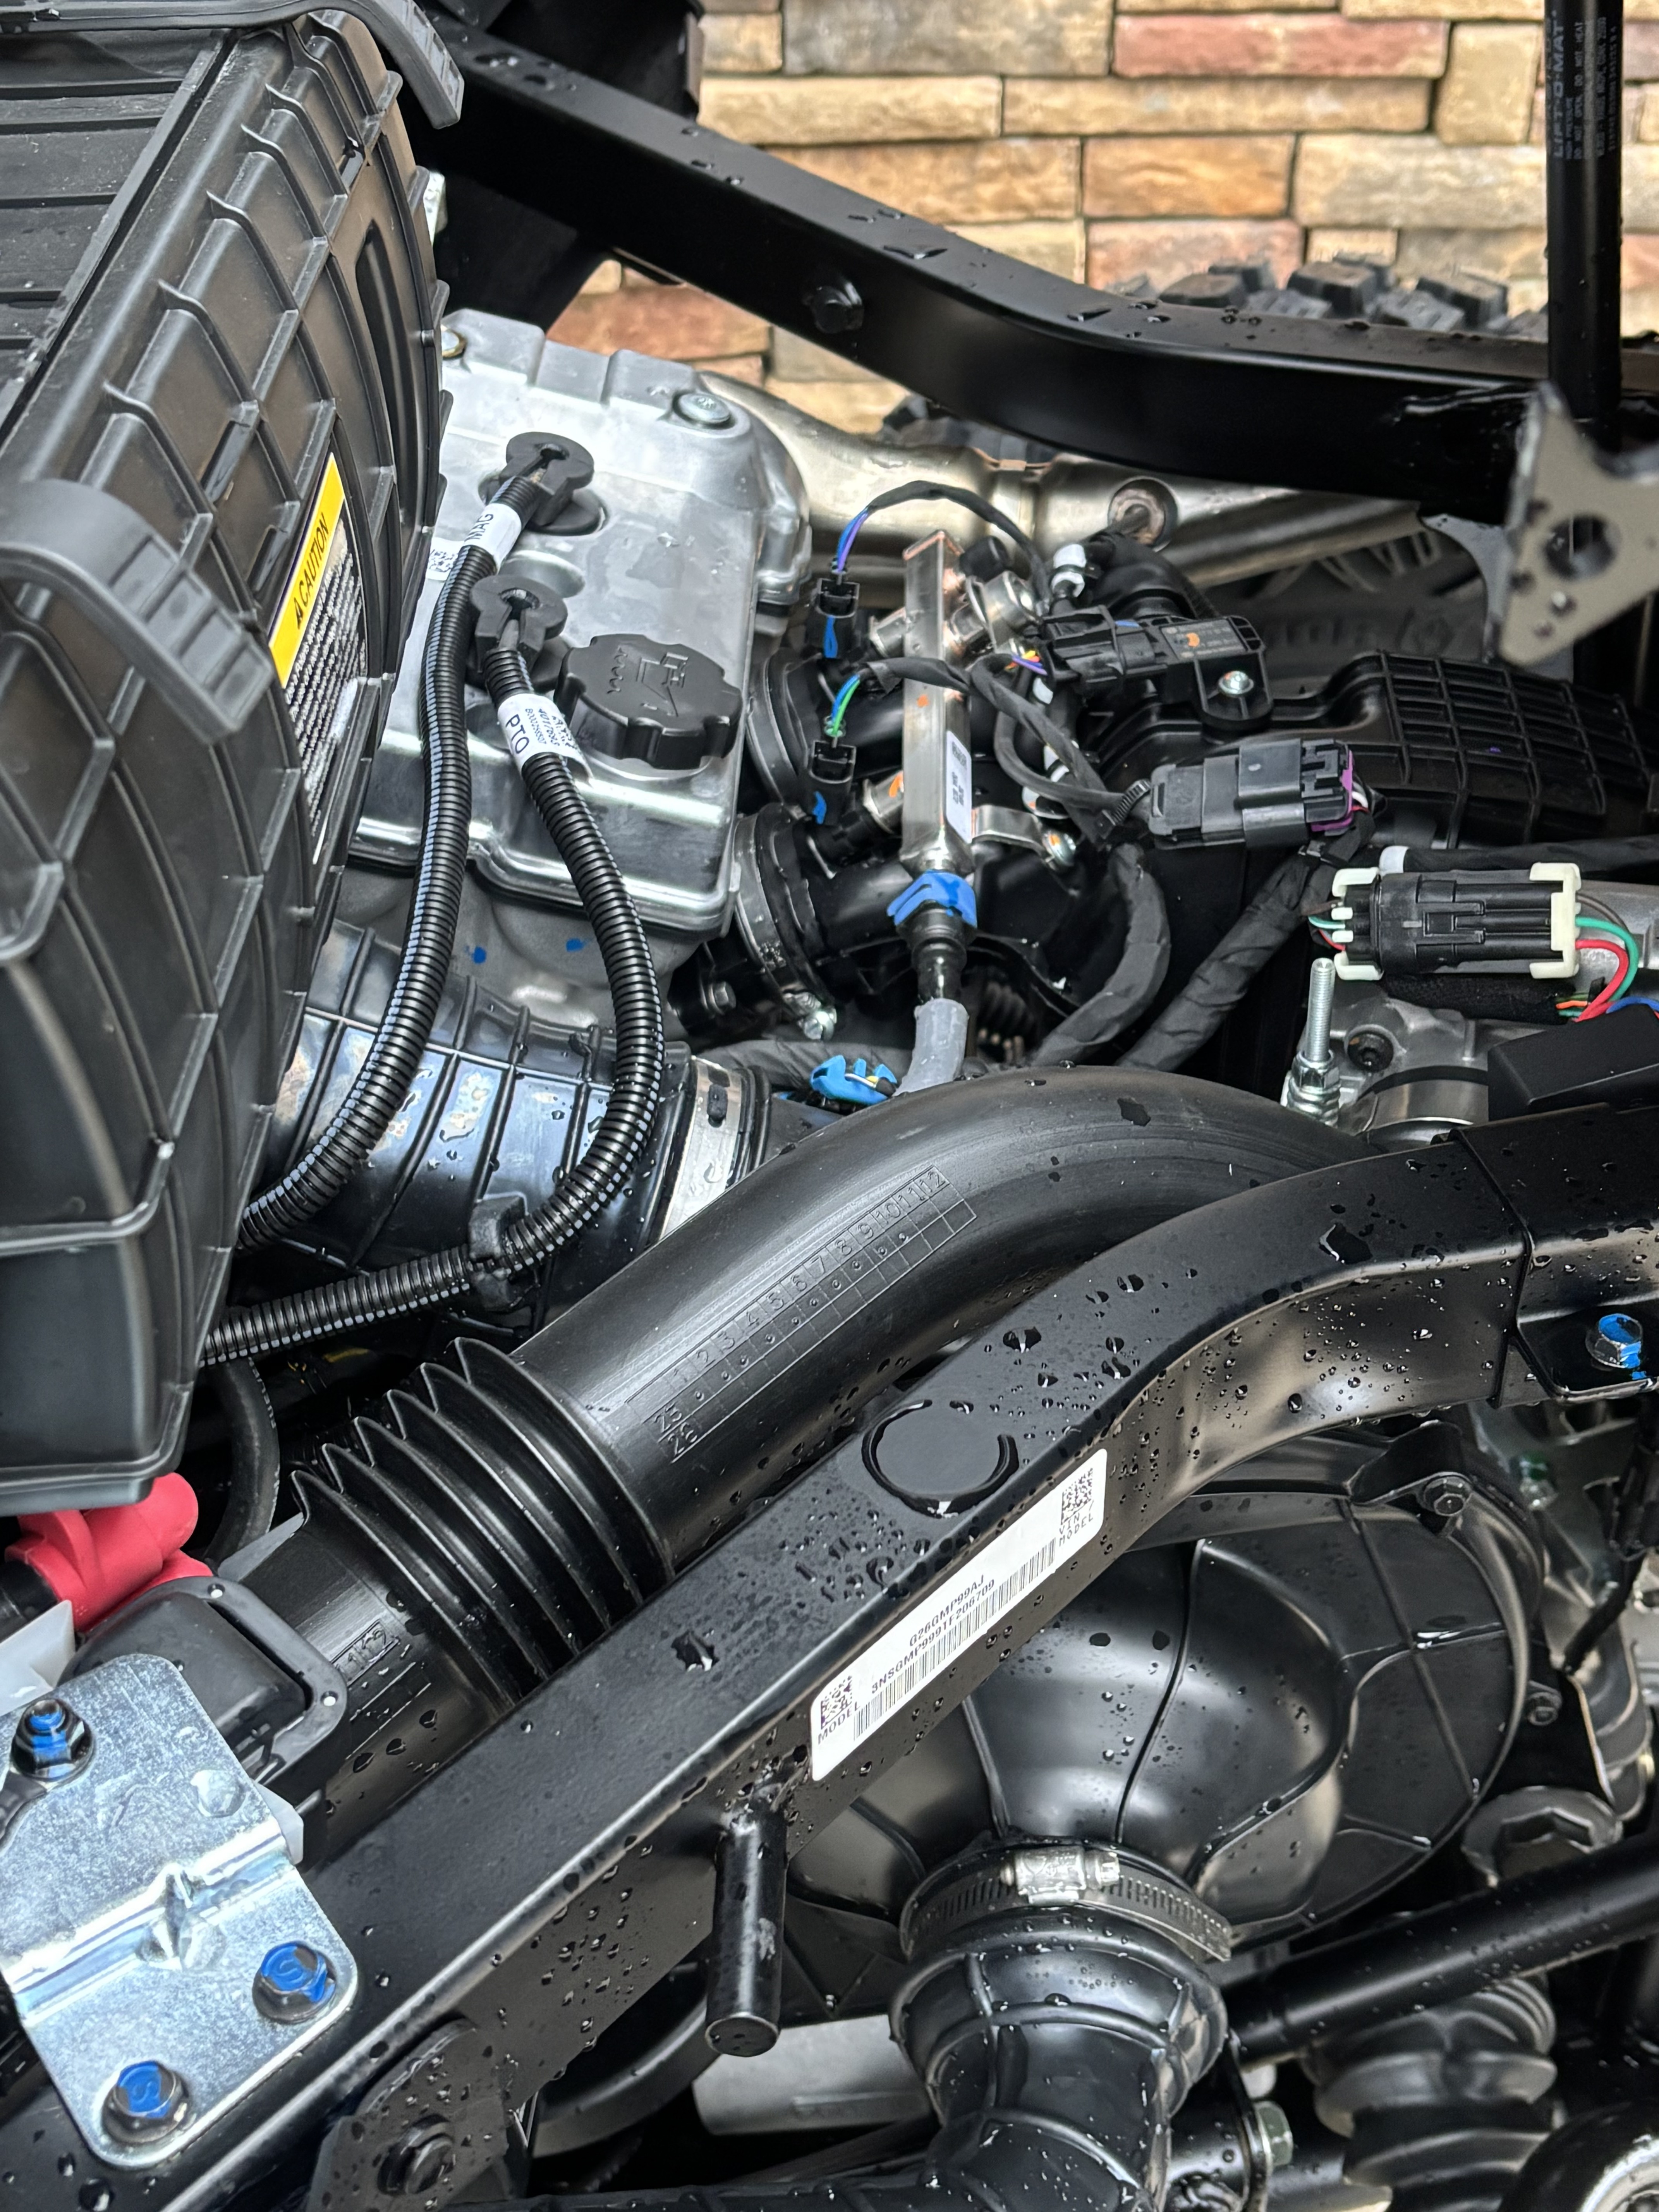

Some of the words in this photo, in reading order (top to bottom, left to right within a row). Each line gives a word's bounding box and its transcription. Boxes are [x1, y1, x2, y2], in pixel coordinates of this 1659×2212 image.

[1553, 20, 1564, 158] LIFT-O-MAT
[464, 514, 494, 543] MAG
[299, 512, 329, 598] CAUTION
[506, 714, 530, 754] PTO
[1059, 1515, 1080, 1534] VIN
[1059, 1513, 1094, 1547] MODEL
[909, 1574, 985, 1647] G26GMP99AJ
[817, 1701, 861, 1744] MODEL
